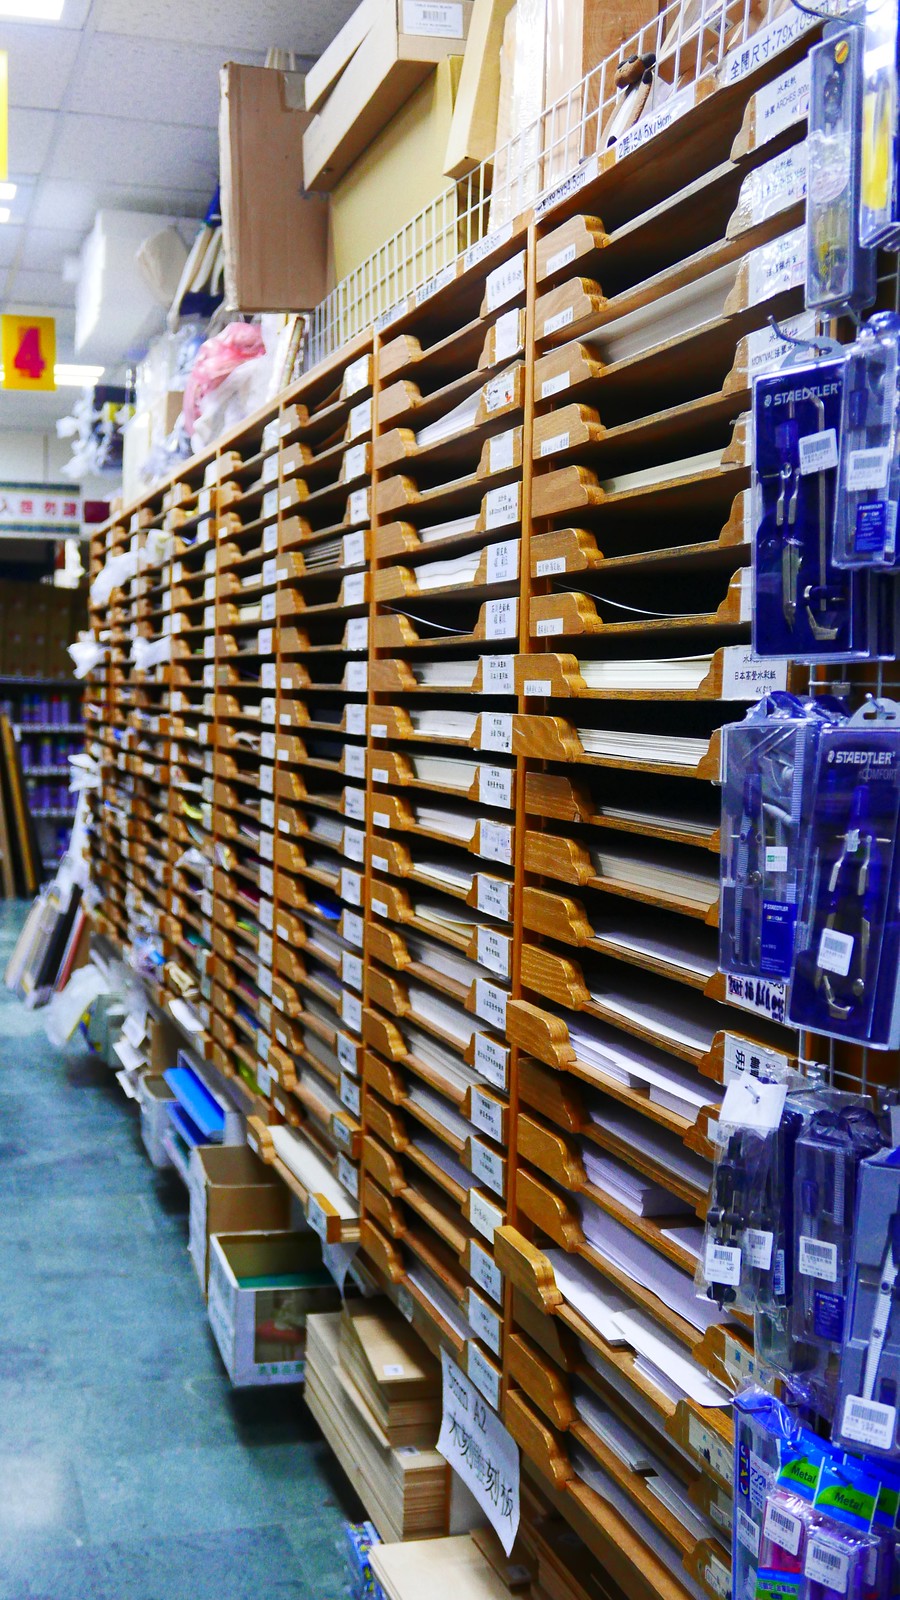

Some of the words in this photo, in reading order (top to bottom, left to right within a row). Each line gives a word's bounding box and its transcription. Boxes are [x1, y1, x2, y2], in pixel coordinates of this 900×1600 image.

[14, 327, 45, 378] 4
[773, 383, 838, 406] STAEDTLER
[835, 751, 892, 764] STAEDTLER
[791, 1464, 817, 1484] Metal
[834, 1491, 864, 1511] Metal
